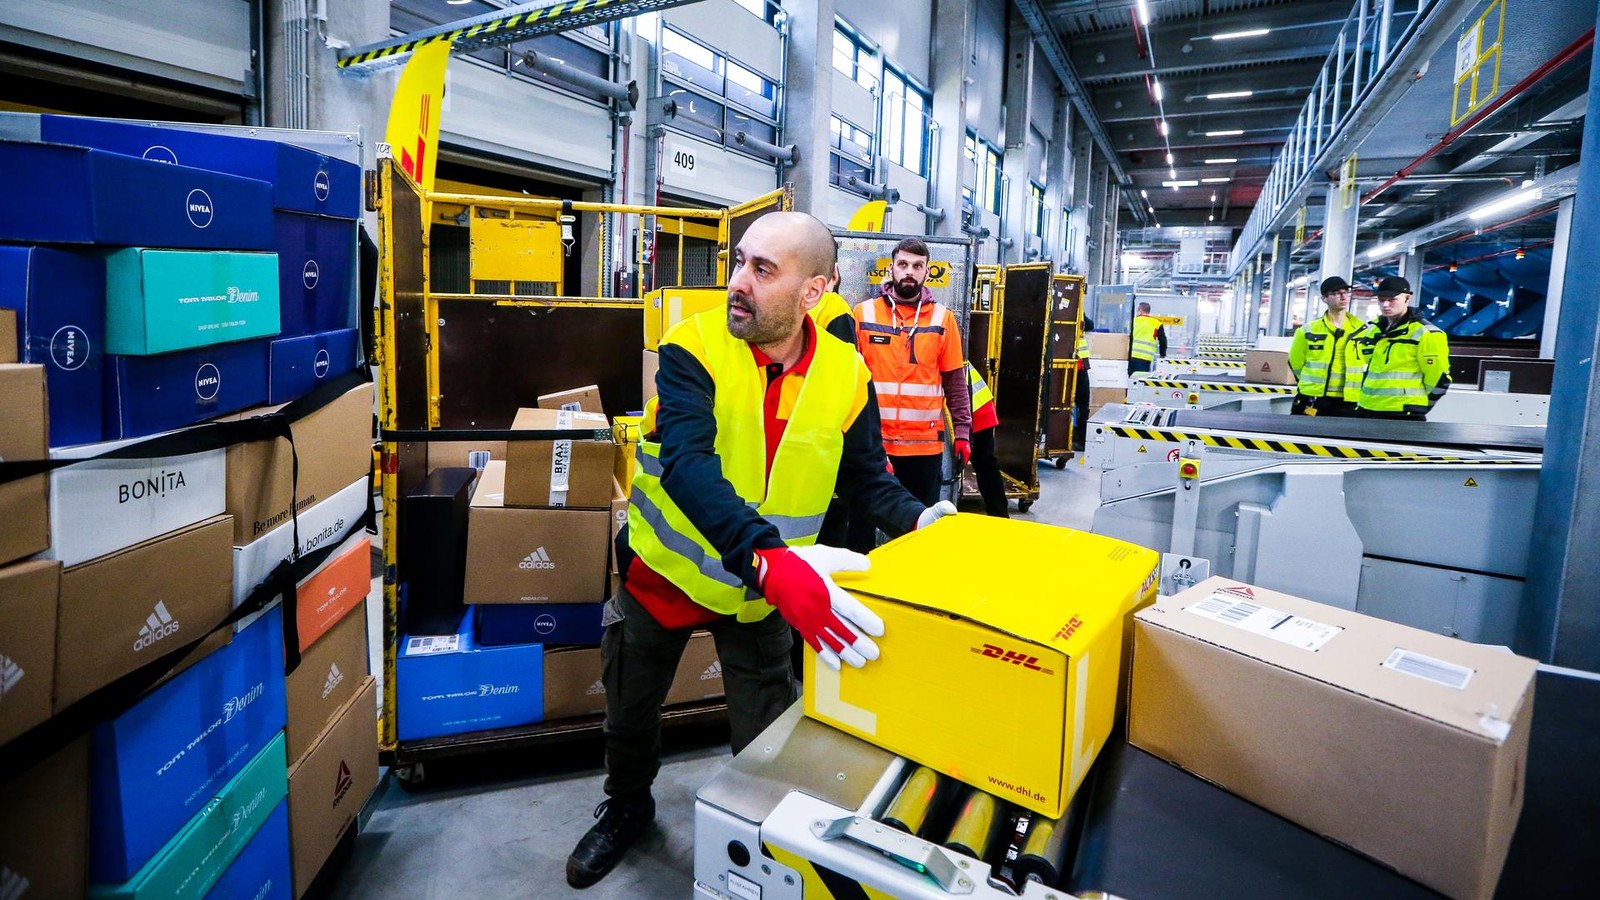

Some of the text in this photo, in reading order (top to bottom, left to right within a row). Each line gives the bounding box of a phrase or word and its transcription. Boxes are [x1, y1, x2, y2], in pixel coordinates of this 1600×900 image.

[674, 151, 694, 170] 409
[190, 203, 211, 214] NIVEA
[227, 286, 259, 304] Denim
[66, 331, 75, 366] NIVEA
[198, 376, 217, 387] NIVEA
[554, 442, 565, 474] BRAX
[119, 470, 186, 504] BONITA
[253, 520, 266, 536] Be
[267, 509, 289, 528] more
[518, 560, 555, 569] adidas
[316, 586, 348, 614] TOM TAILOR
[133, 619, 180, 652] adidas
[981, 643, 1043, 672] DHL
[321, 672, 344, 699] adidas
[445, 690, 478, 698] TAILOR
[478, 683, 520, 697] Denim
[156, 682, 264, 776] TOM TAILOR Denim
[988, 776, 1046, 803] www.dhl.de
